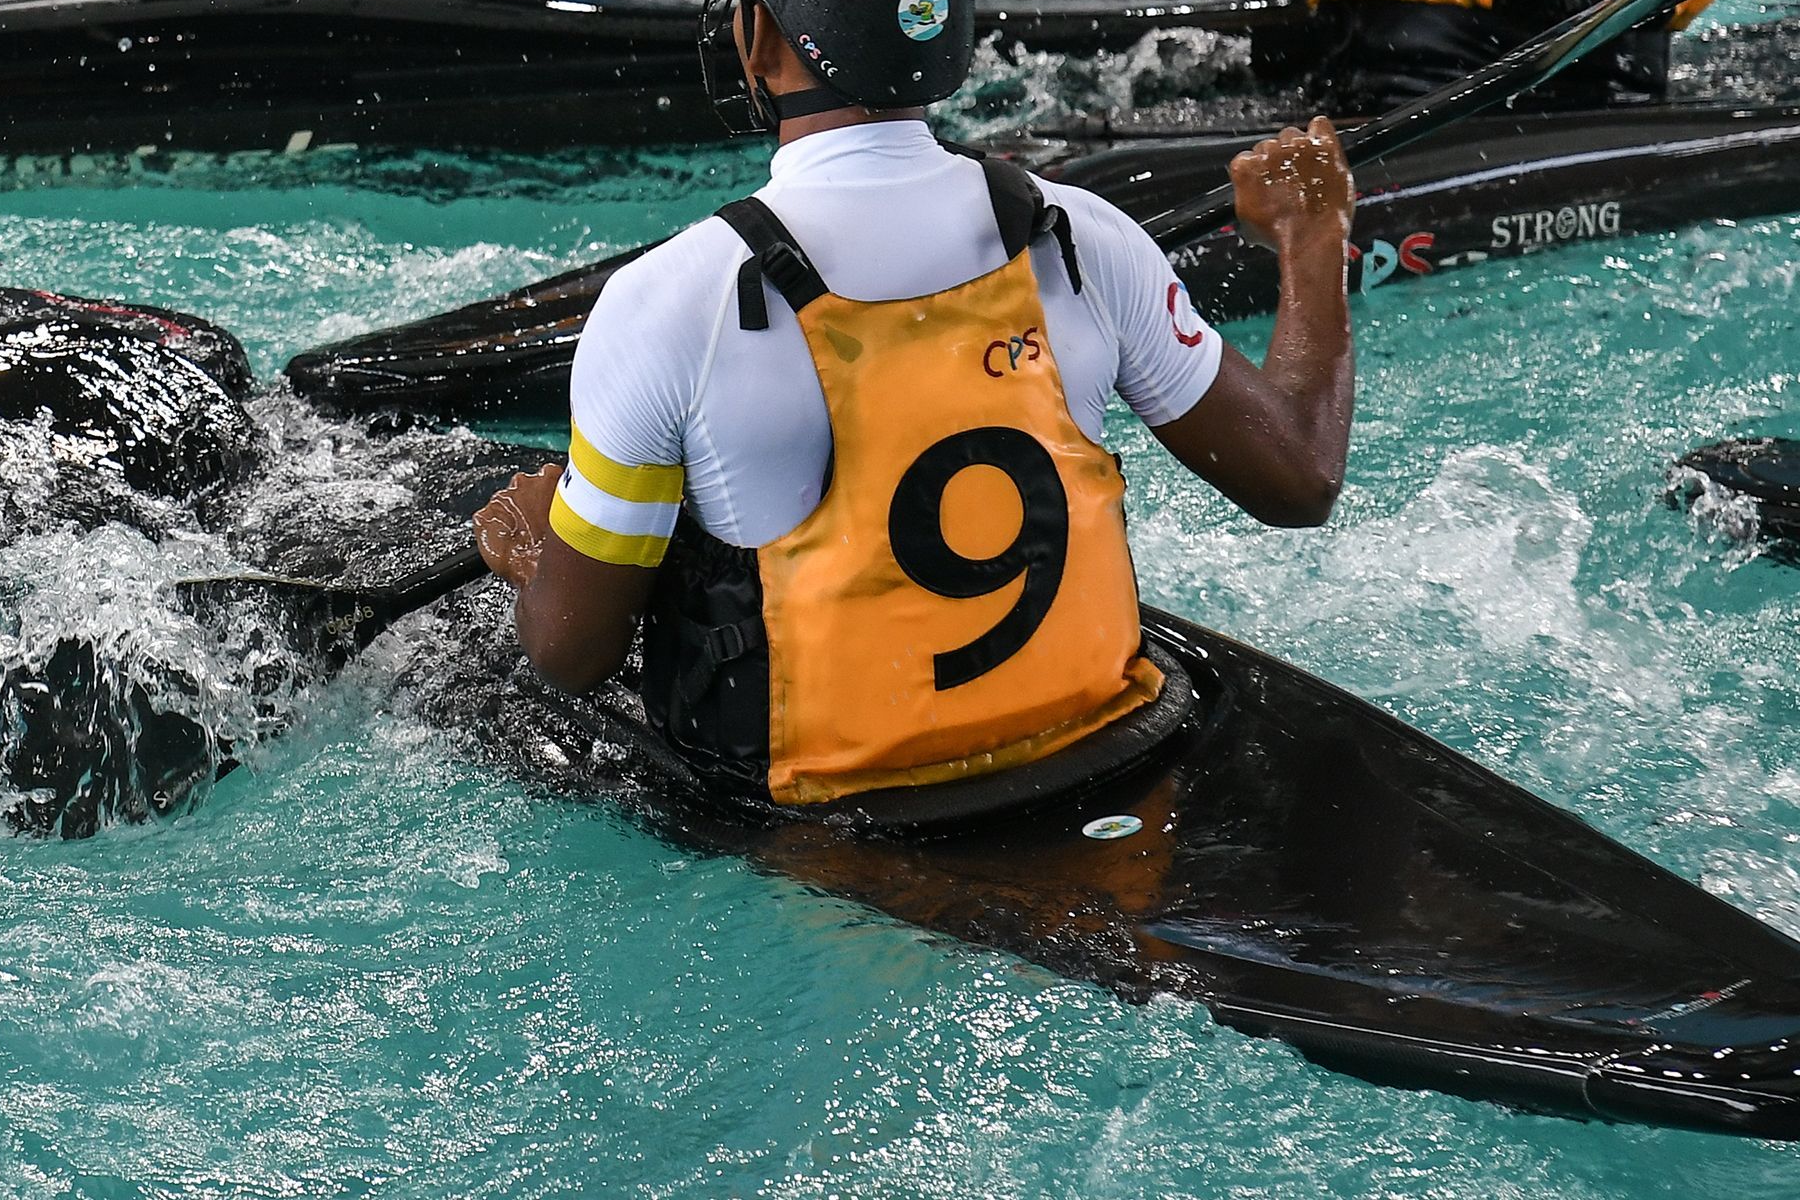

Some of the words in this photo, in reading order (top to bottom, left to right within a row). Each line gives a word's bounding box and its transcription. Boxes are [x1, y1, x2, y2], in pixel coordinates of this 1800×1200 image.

[799, 34, 822, 60] CPS
[1491, 201, 1621, 249] STRONG
[1348, 231, 1436, 296] PS
[983, 326, 1041, 378] CPS
[888, 426, 1069, 691] 9
